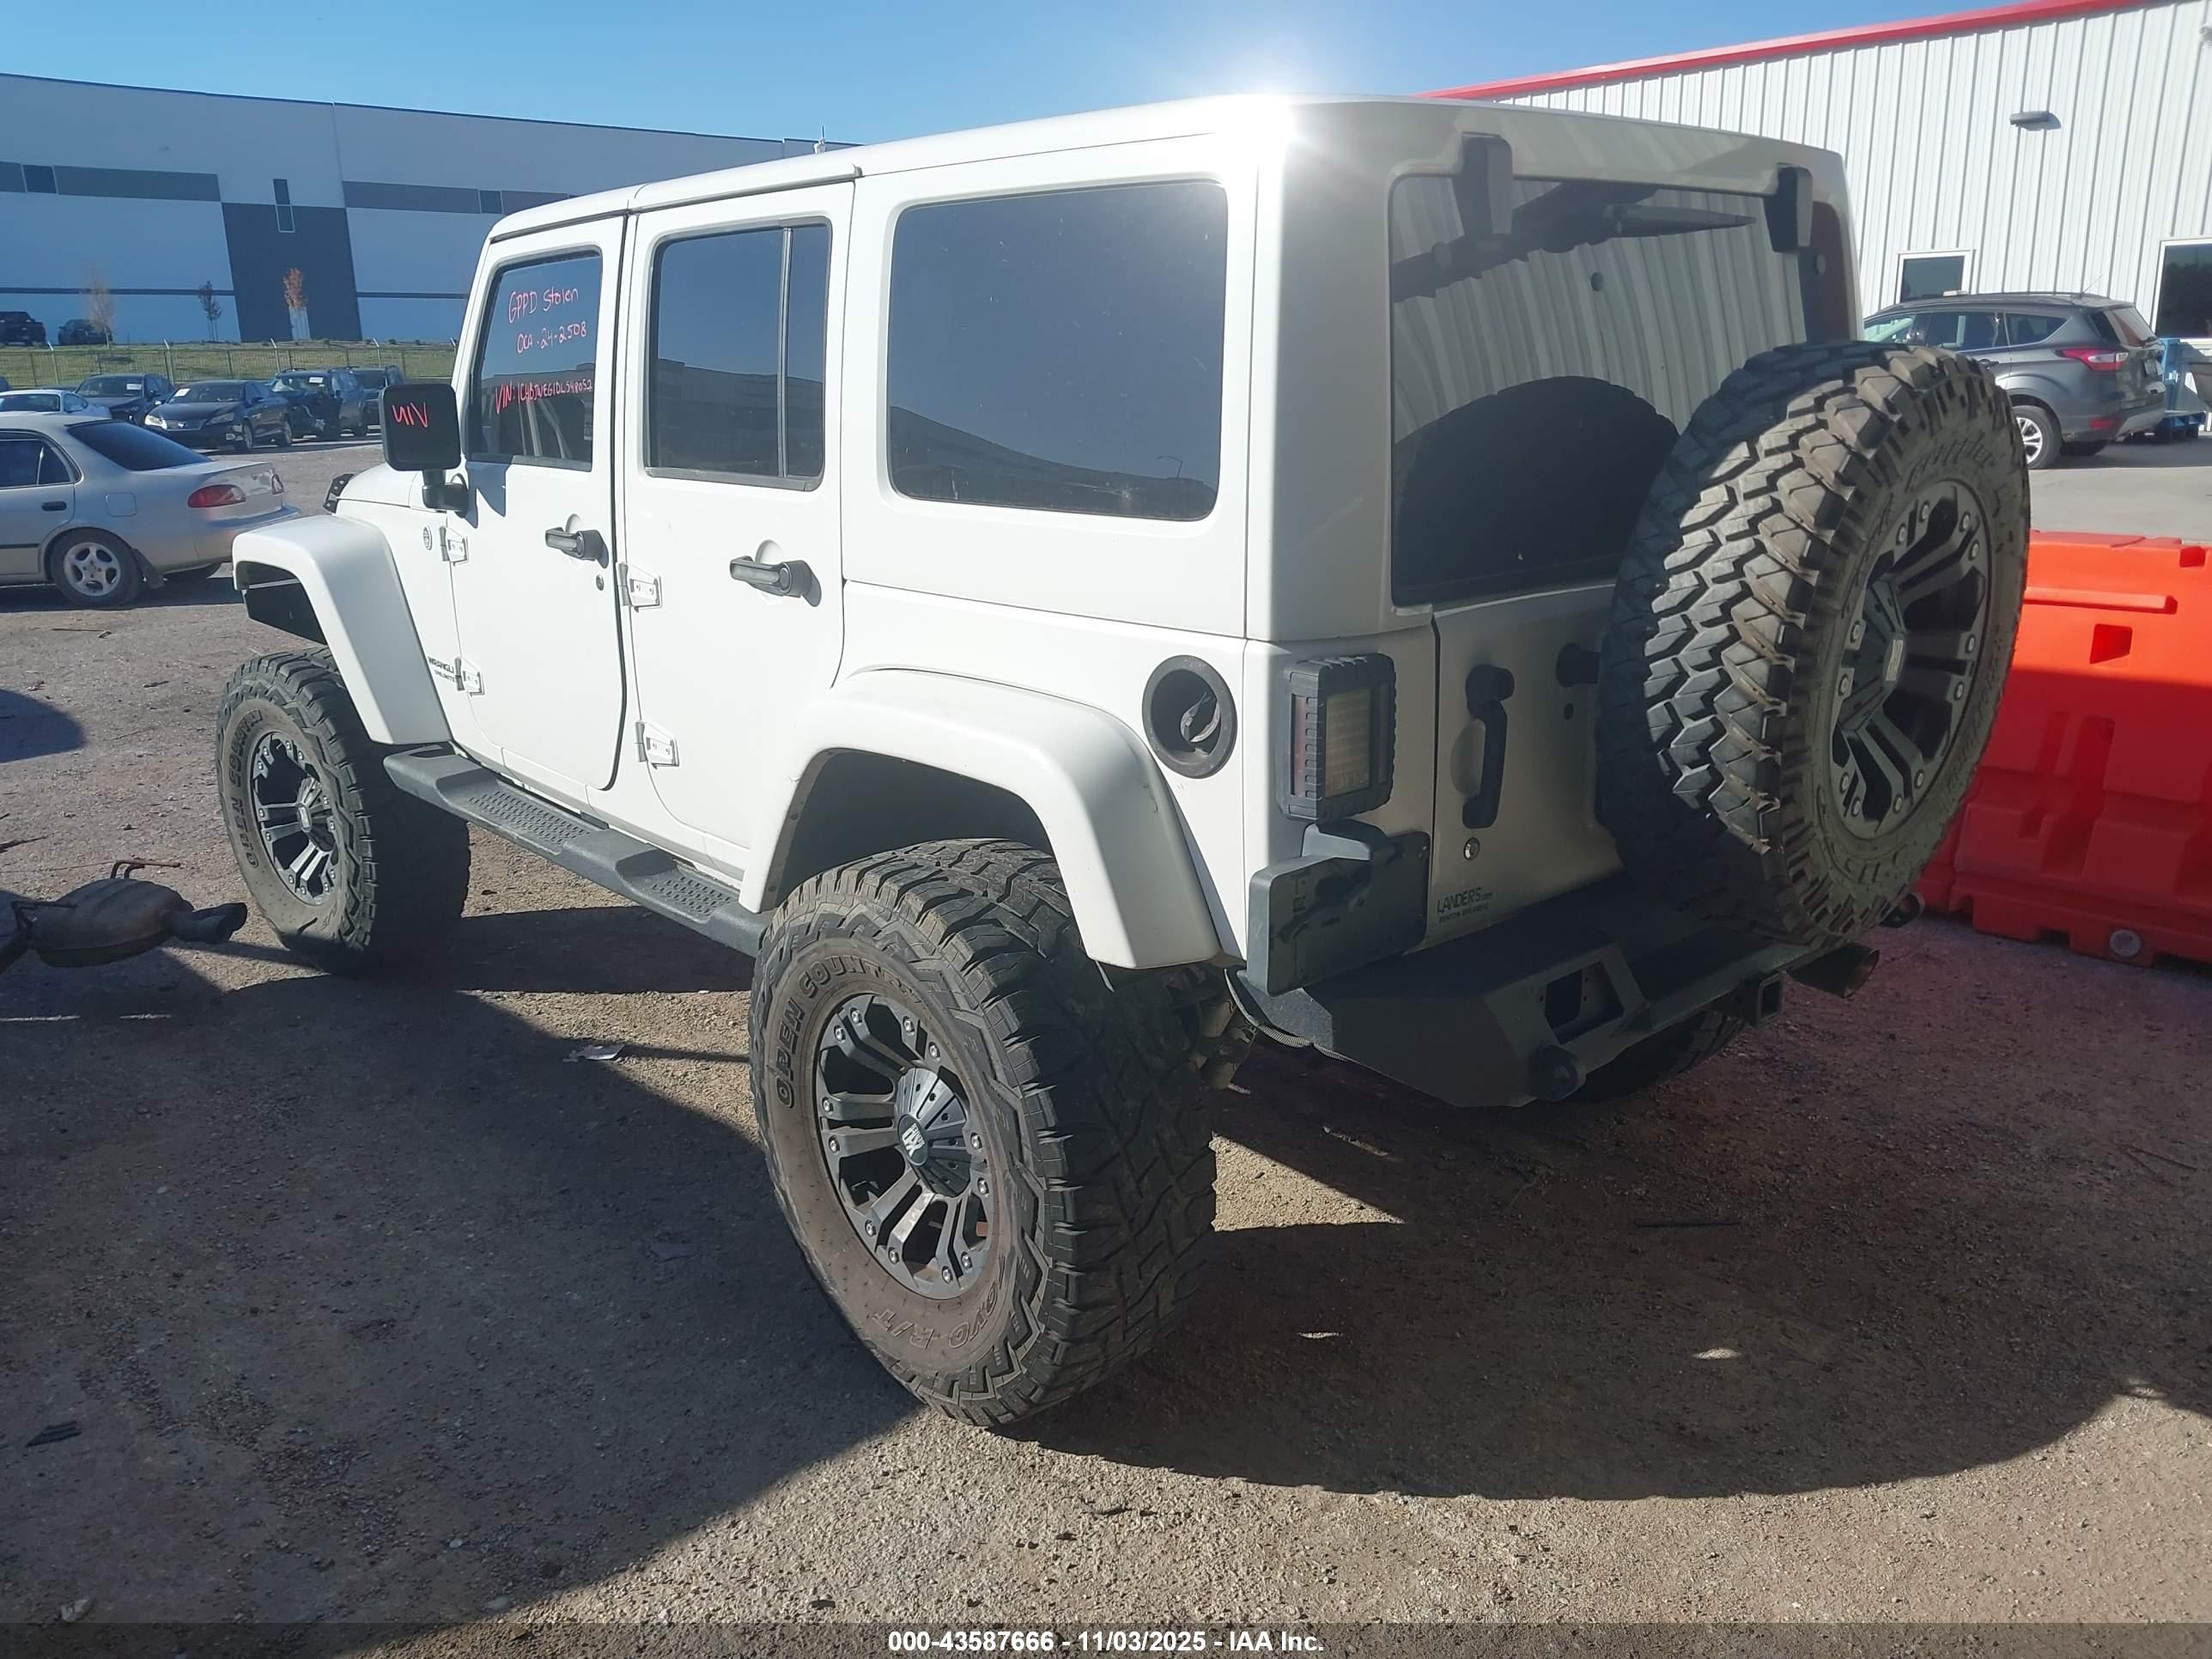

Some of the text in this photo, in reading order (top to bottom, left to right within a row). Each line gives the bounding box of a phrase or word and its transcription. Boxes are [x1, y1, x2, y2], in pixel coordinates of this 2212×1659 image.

[508, 285, 579, 324] GPPD Stolen
[776, 955, 922, 1109] OPEN COUNTRY
[872, 1308, 934, 1350] R/T
